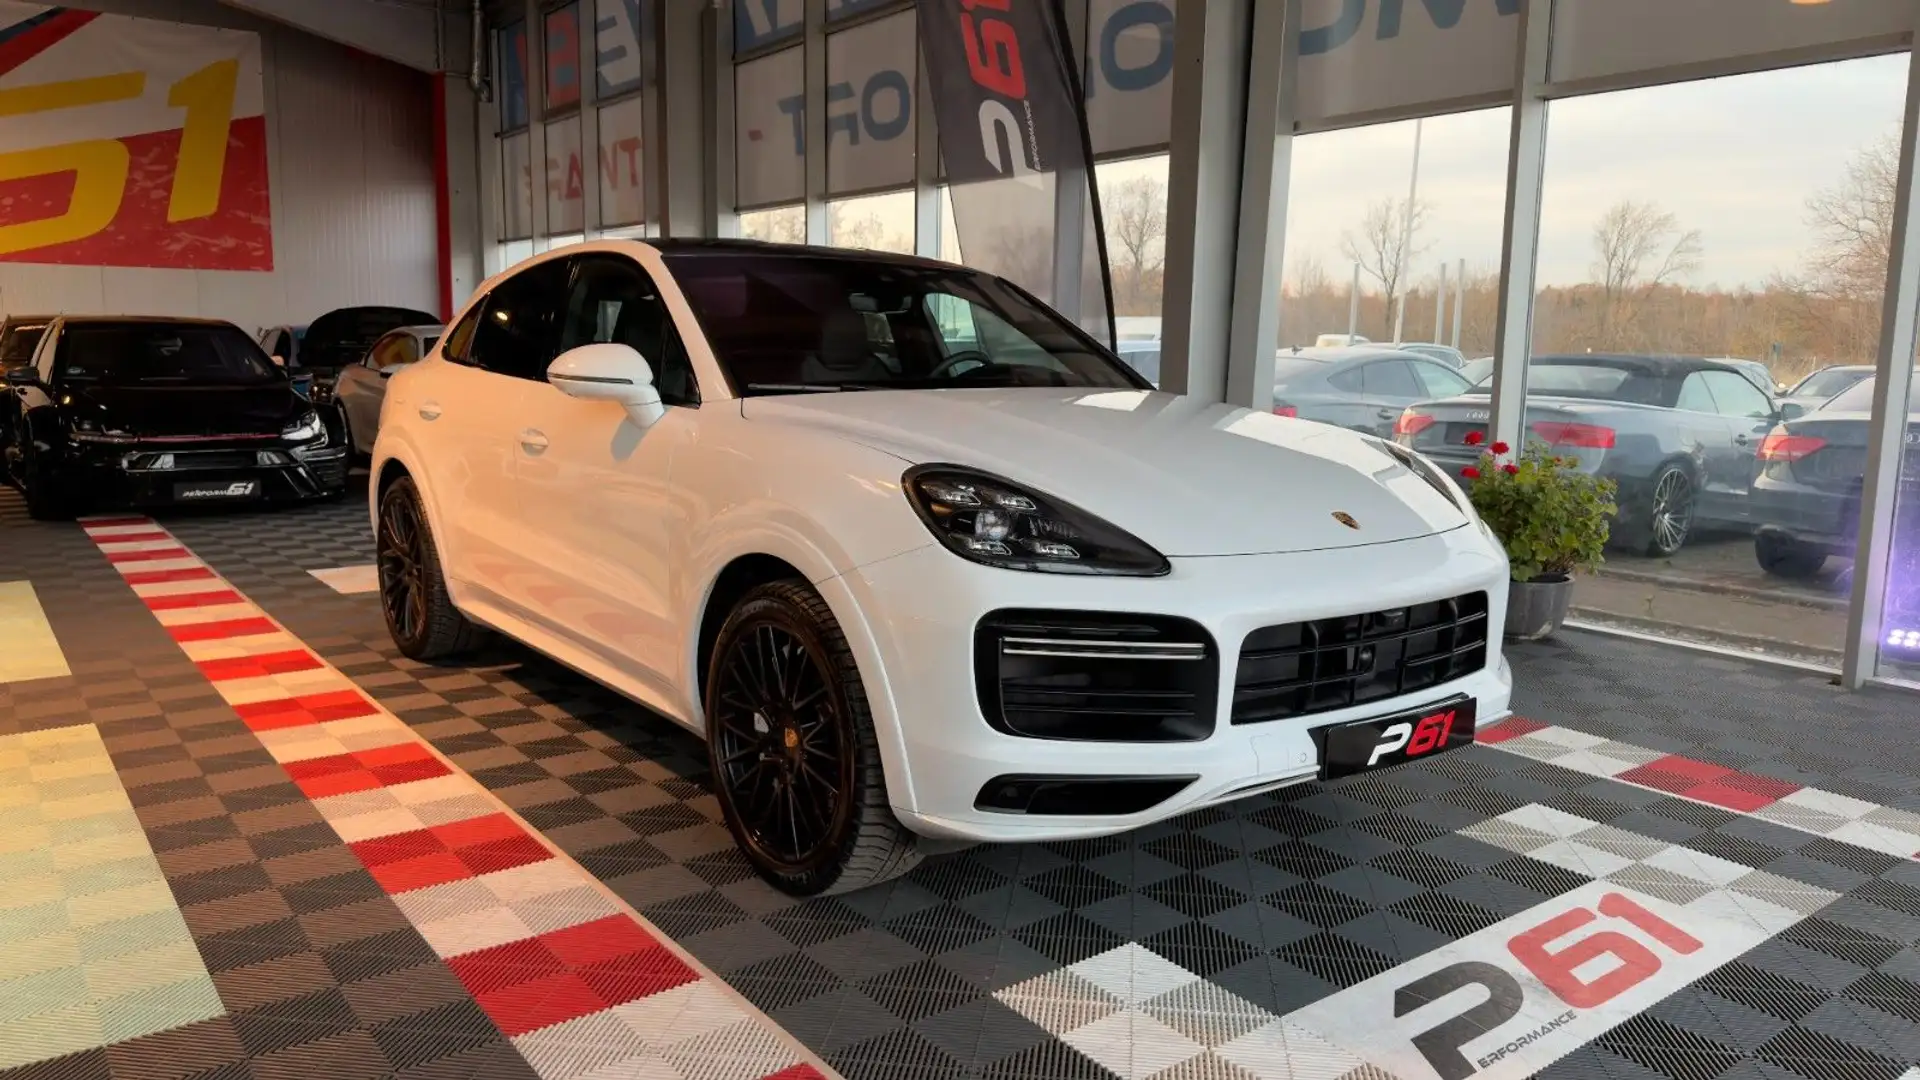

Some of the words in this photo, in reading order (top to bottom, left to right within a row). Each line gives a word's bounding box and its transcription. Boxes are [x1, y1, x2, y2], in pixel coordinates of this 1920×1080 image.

[1367, 711, 1456, 766] P61
[1394, 892, 1704, 1080] P61
[1477, 1009, 1578, 1069] ERFORMANCE
